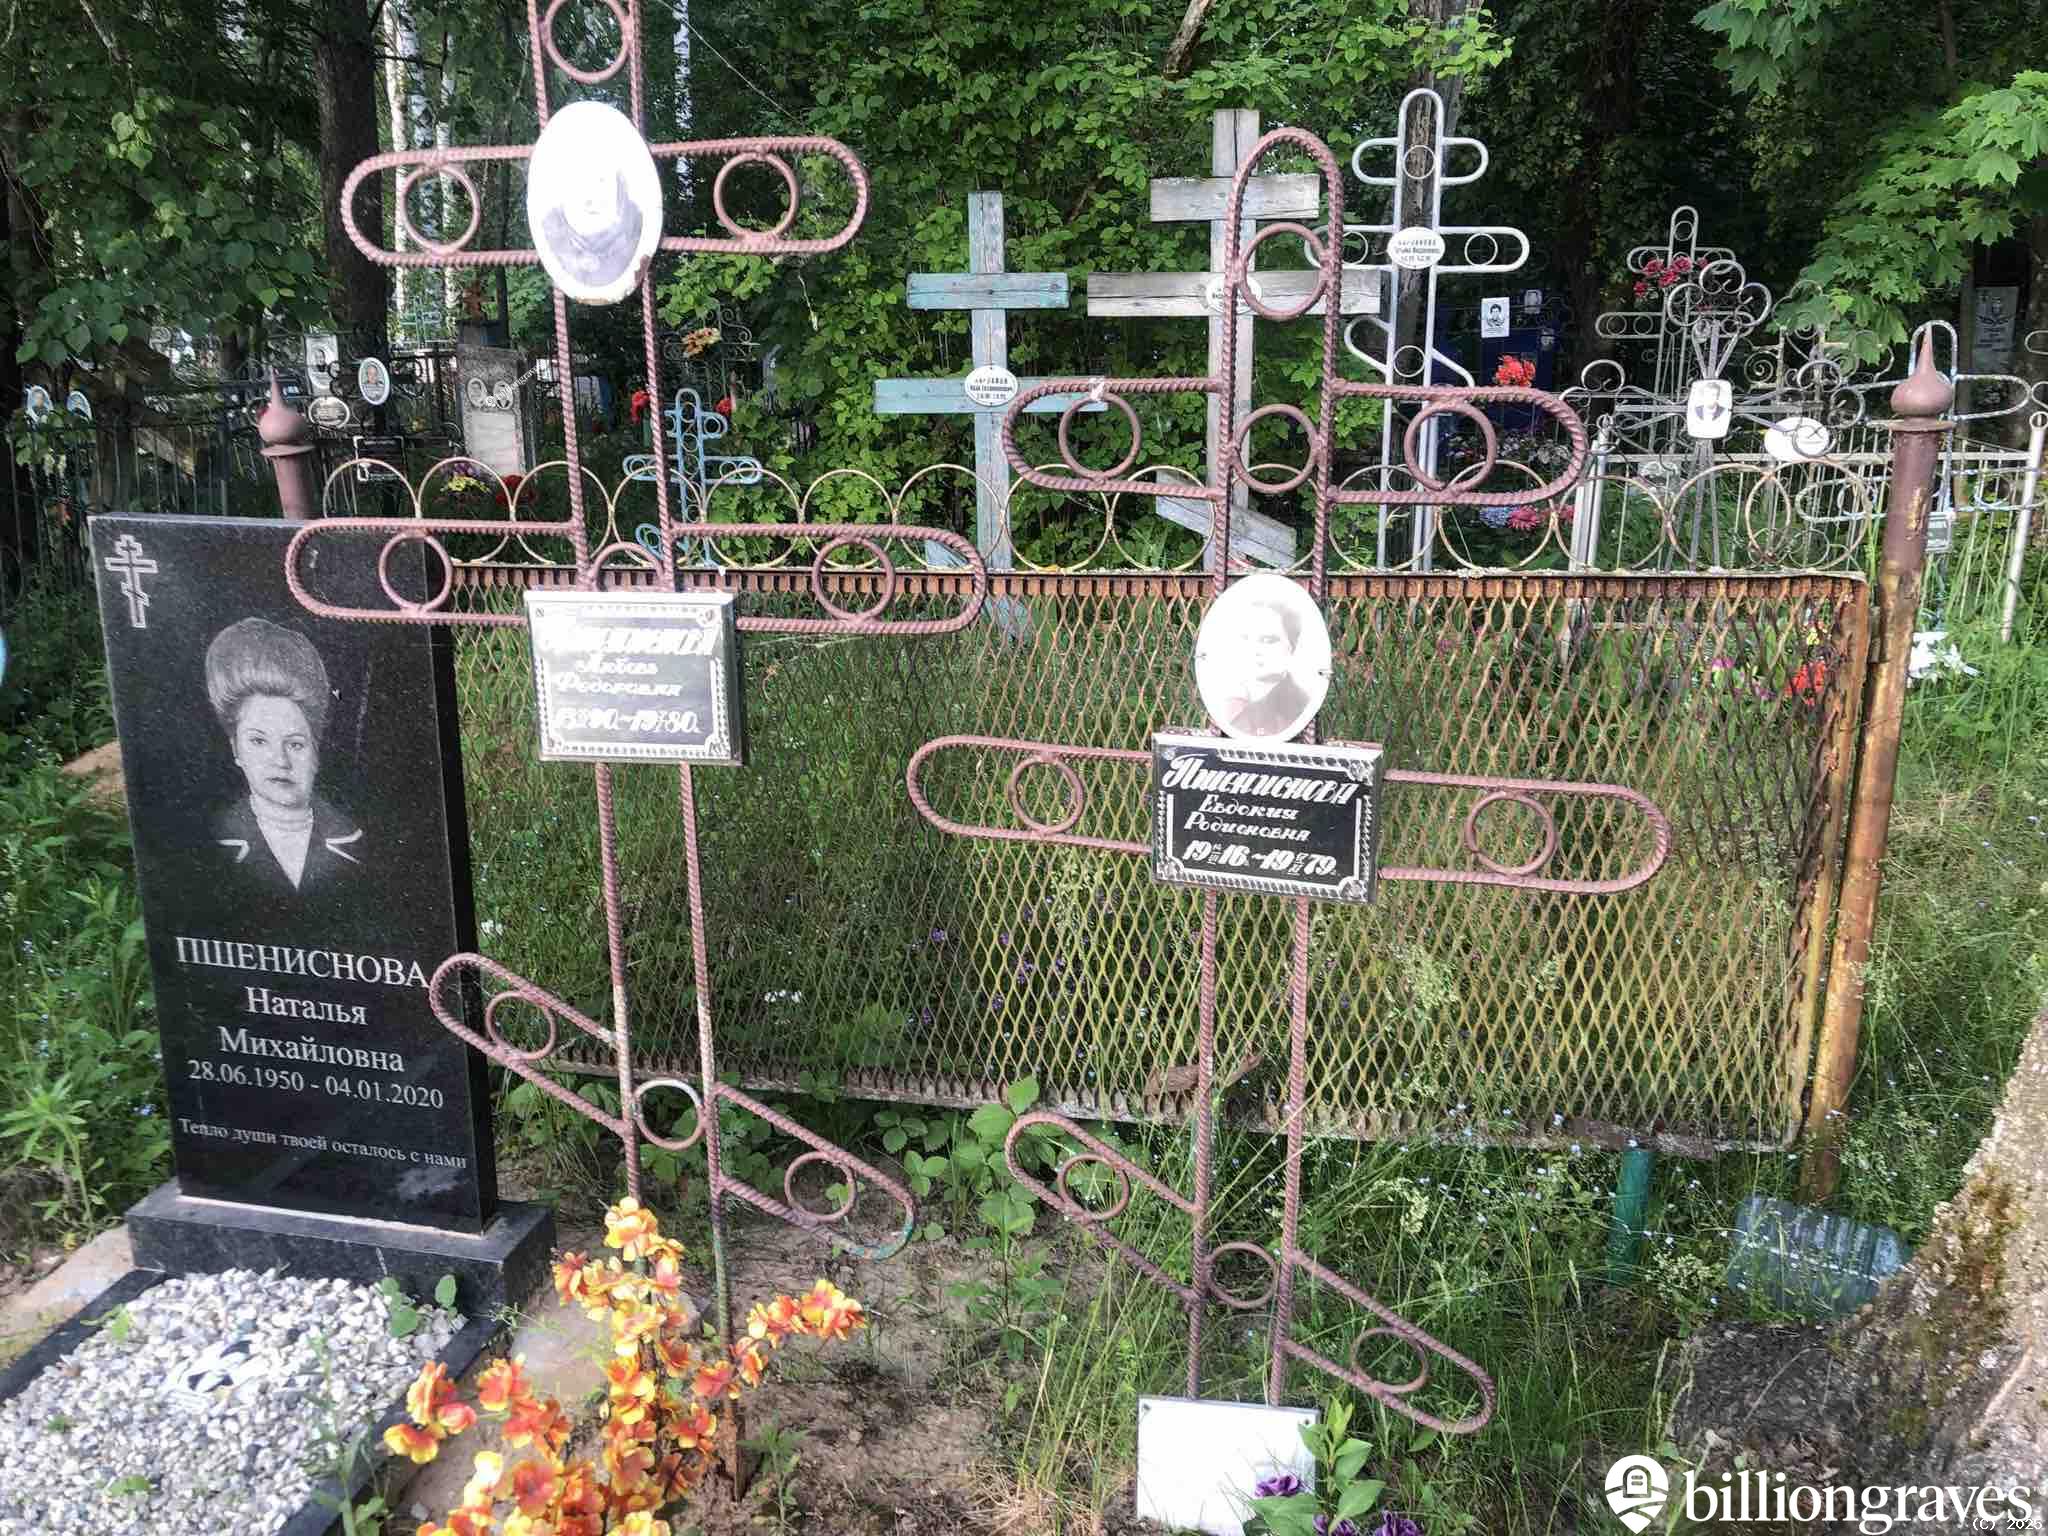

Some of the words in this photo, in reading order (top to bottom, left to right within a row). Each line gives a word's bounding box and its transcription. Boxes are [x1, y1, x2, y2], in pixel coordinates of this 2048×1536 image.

[1184, 812, 1311, 842] Родионовна
[1198, 794, 1299, 820] Евдокия
[176, 936, 431, 988] ПШЕНИСНОВА
[245, 986, 368, 1025] Наталья
[217, 1026, 405, 1072] Михайловна
[187, 1060, 303, 1092] 28.06.1950
[326, 1076, 444, 1109] 04.01.2020
[178, 1118, 229, 1138] Тепло
[233, 1128, 277, 1145] души
[281, 1135, 329, 1150] твоей
[332, 1141, 406, 1160] осталось
[410, 1151, 420, 1163] с
[424, 1152, 467, 1169] нами
